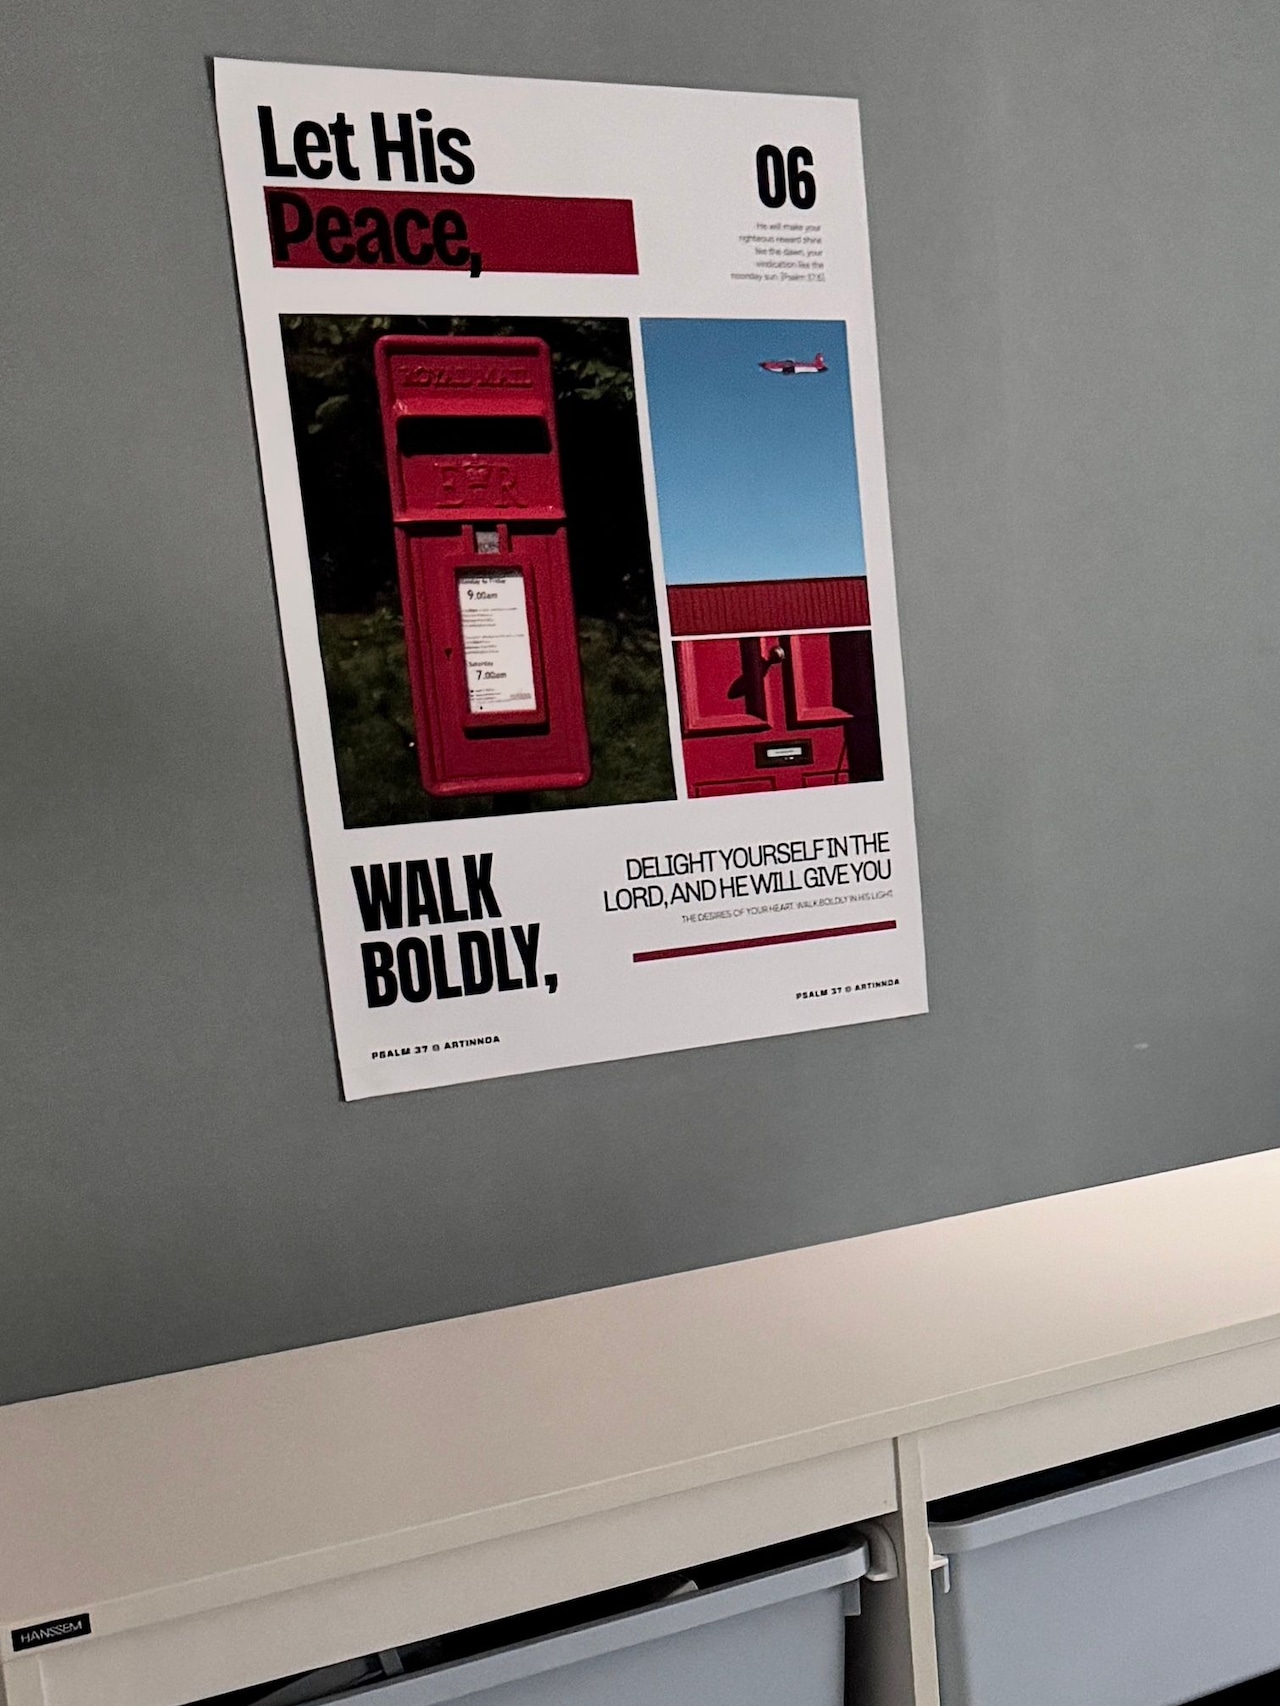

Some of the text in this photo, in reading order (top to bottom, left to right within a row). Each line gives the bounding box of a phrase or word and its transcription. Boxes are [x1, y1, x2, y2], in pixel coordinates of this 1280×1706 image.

[257, 105, 475, 185] Let His
[756, 144, 816, 209] 06
[266, 190, 483, 278] Peace,
[603, 859, 892, 912] LORD, AND HE WILL GIVE YOU
[626, 831, 891, 881] DELIGHT YOURSELF IN THE
[350, 852, 502, 932] WALK
[360, 922, 558, 1009] BOLDLY,
[795, 989, 828, 1000] PSALM
[371, 1047, 411, 1060] PSALM
[414, 1045, 429, 1054] 37
[20, 1620, 83, 1644] HANSSEM
